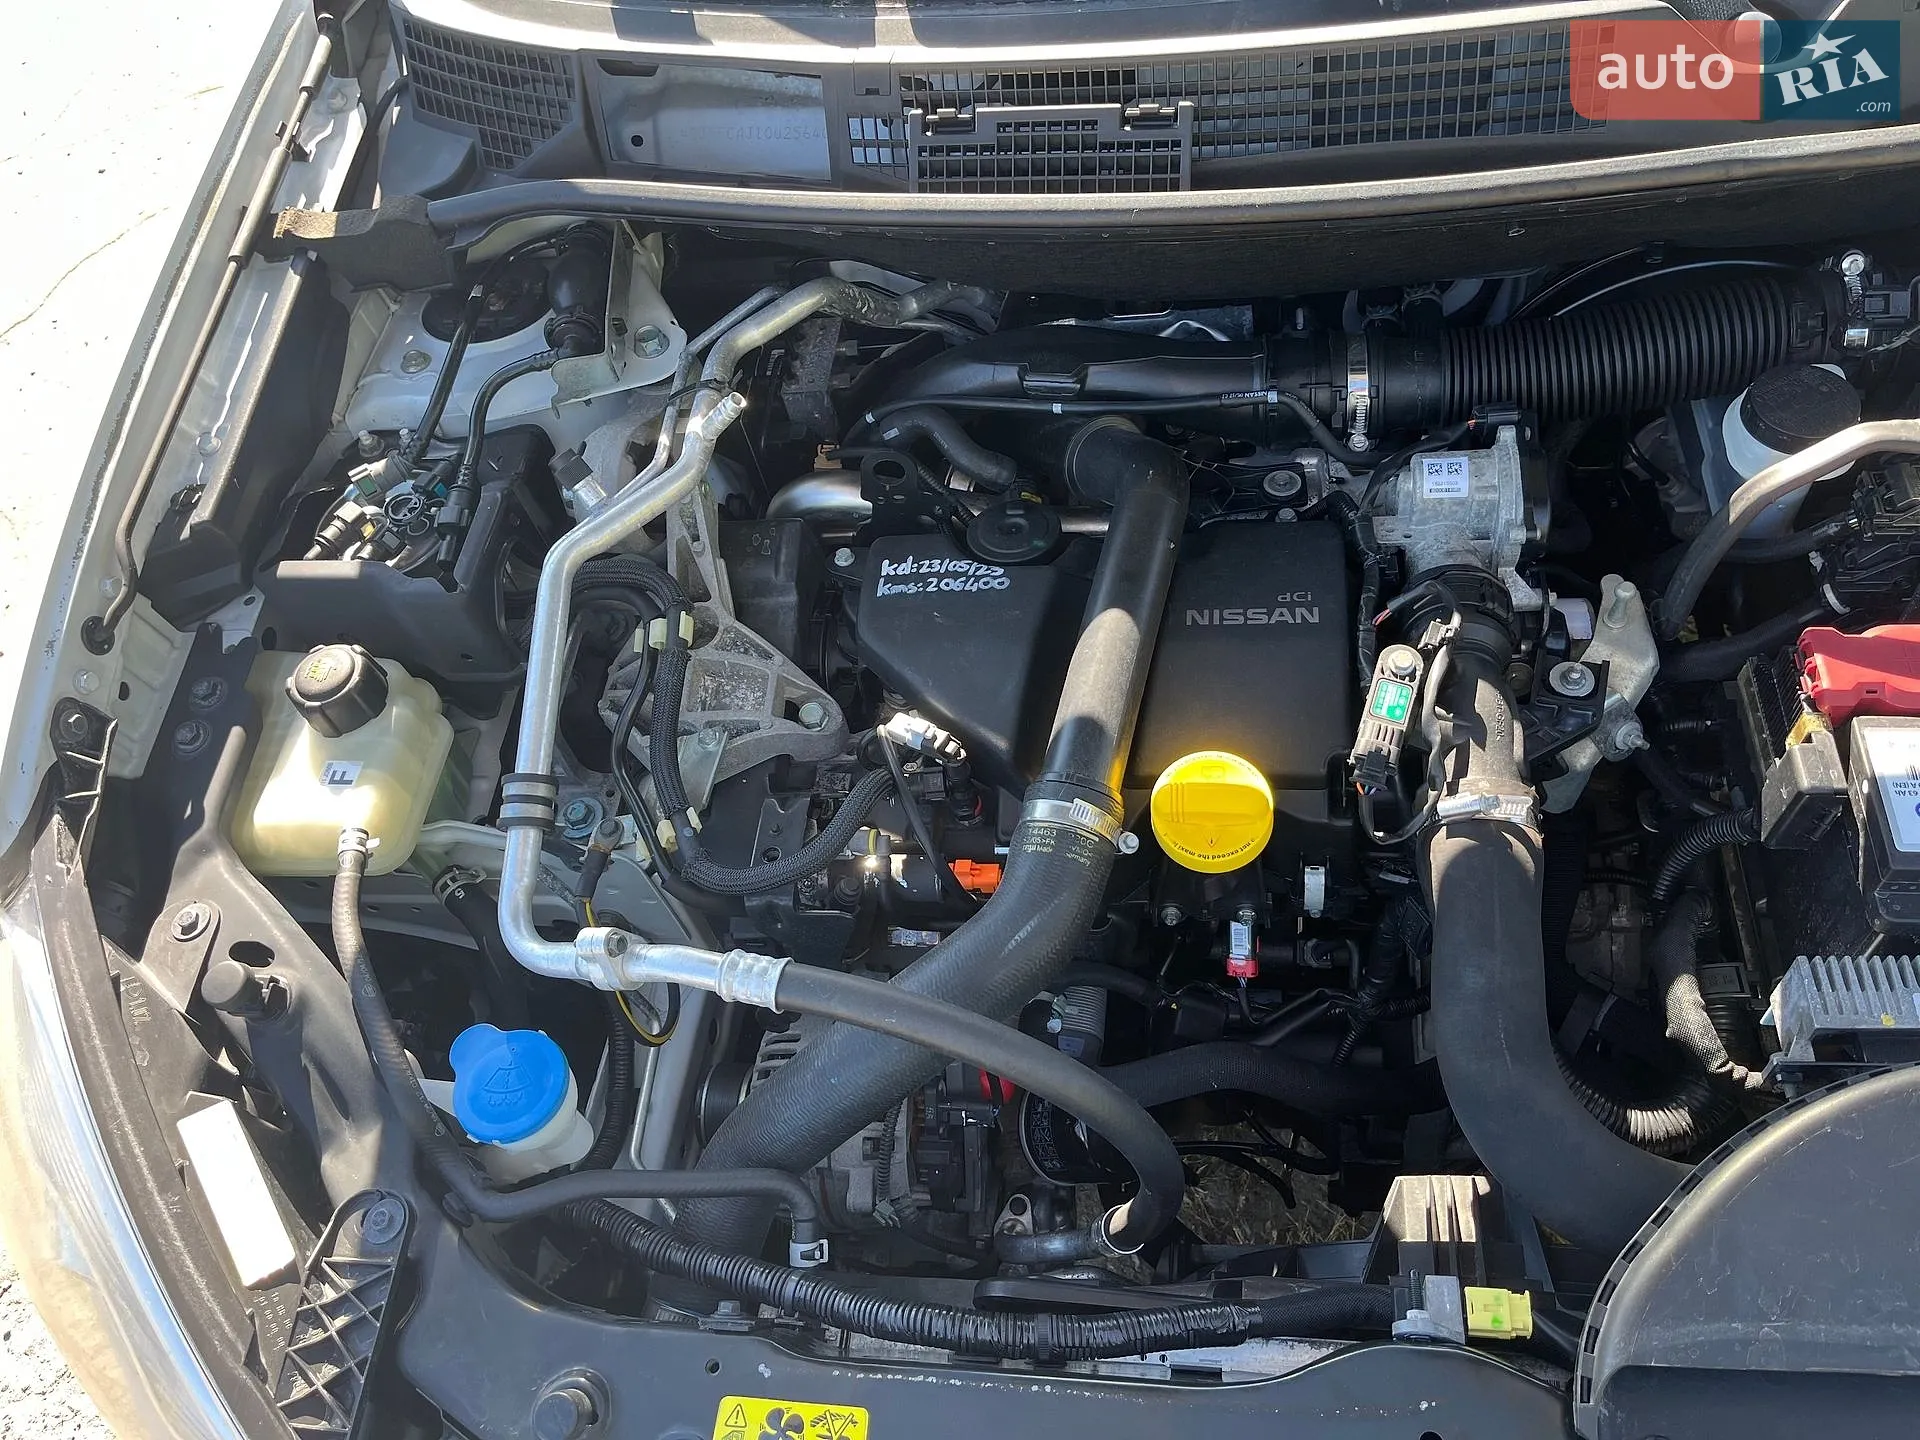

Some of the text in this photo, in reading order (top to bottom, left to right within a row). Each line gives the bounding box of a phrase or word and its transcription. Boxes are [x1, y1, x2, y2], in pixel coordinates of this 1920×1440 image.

[1277, 591, 1312, 602] dCi
[1185, 606, 1320, 626] NISSAN
[327, 770, 354, 785] F
